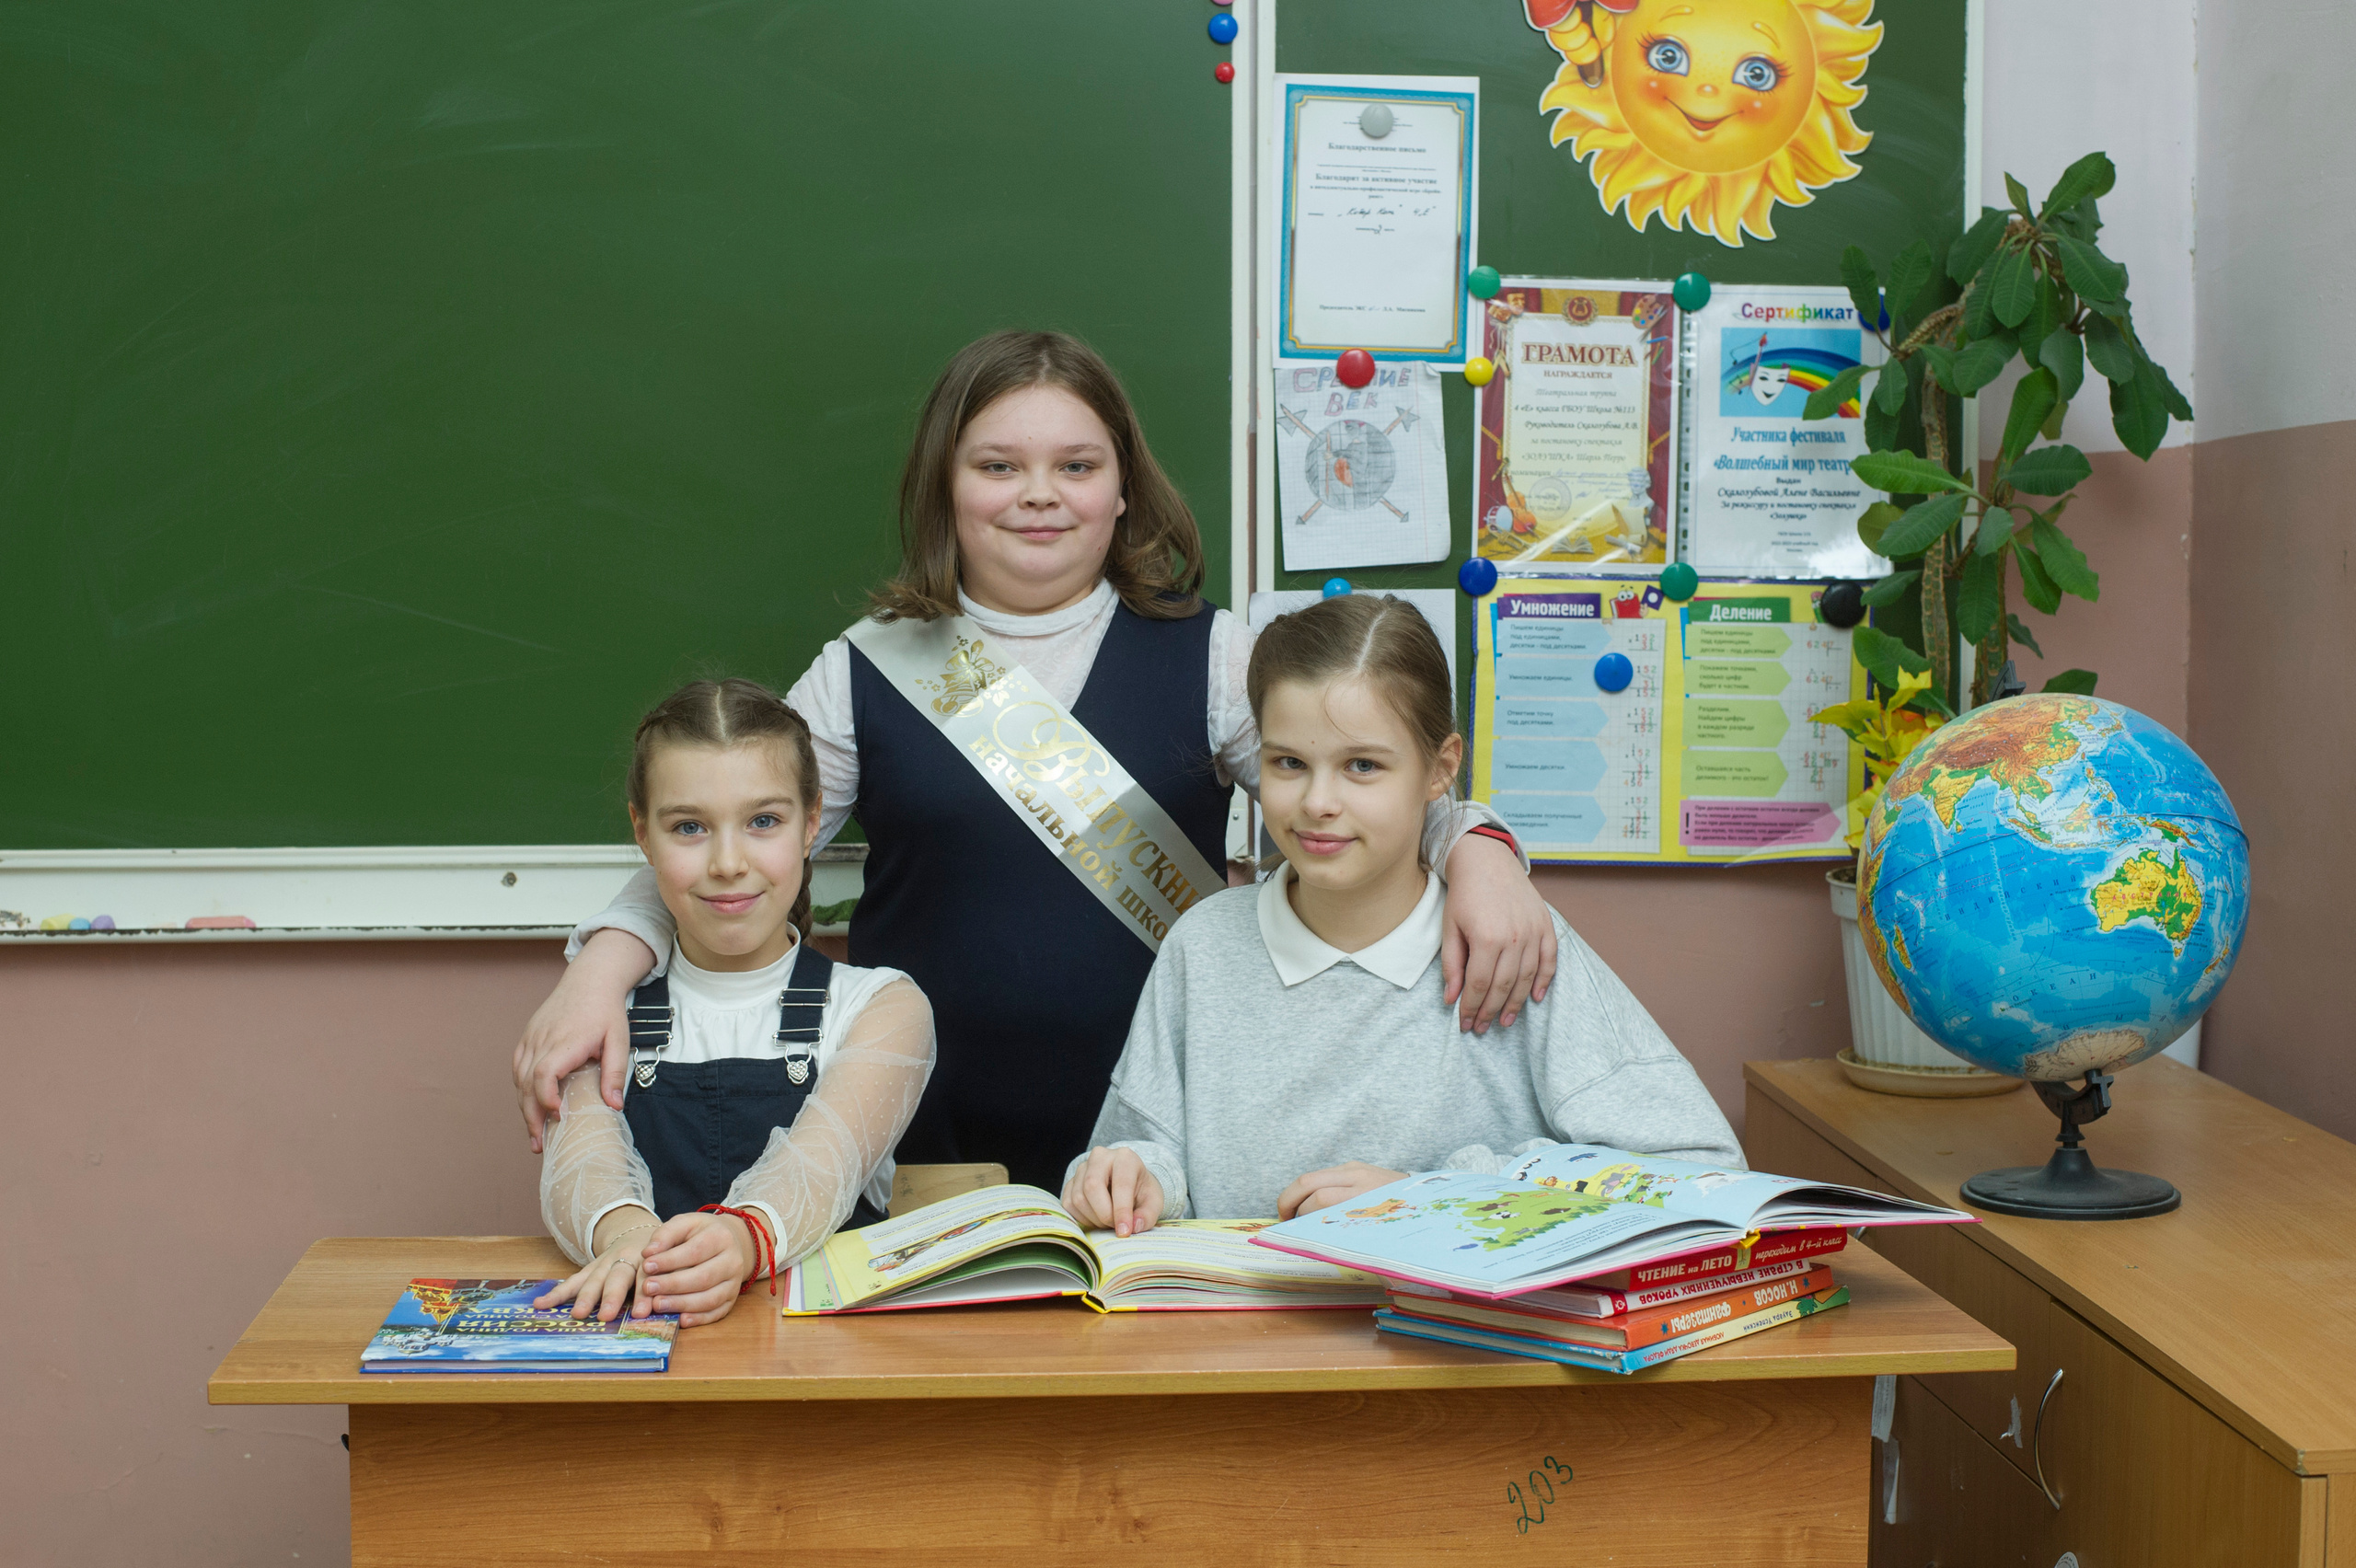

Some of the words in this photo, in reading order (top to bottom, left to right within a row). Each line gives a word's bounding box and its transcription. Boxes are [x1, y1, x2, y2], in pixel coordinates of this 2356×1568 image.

[1741, 303, 1854, 322] Сертификат
[1523, 343, 1635, 365] ГРАМОТА
[1543, 370, 1612, 379] НАГРАЖДАЕТСЯ
[1324, 391, 1379, 417] ВЕК
[1731, 426, 1787, 443] Участника
[1789, 426, 1846, 446] фестиваля
[1714, 455, 1788, 470] «Волшебный
[1792, 457, 1816, 475] мир
[1776, 477, 1801, 485] Выдан
[1510, 599, 1595, 617] Умножение
[1710, 605, 1772, 621] Деление
[1637, 1263, 1686, 1283] ЧТЕНИЕ
[1688, 1265, 1698, 1274] на
[1700, 1253, 1732, 1273] ЛЕТО
[1755, 1243, 1796, 1262] переходим
[1823, 1234, 1843, 1249] класс
[1796, 1260, 1804, 1271] В
[1758, 1261, 1794, 1278] СТРАНЕ
[1680, 1271, 1755, 1295] НЕВЫУЧЕННЫХ
[1785, 1279, 1798, 1294] Н.
[1638, 1287, 1679, 1305] УРОКОВ
[1753, 1283, 1787, 1307] НОСОВ
[458, 1320, 606, 1328] РОССИЯ
[1743, 1314, 1773, 1332] Успенский
[1663, 1344, 1678, 1355] ДЯДИ
[1677, 1338, 1701, 1353] ДЕВОЧКА
[1507, 1455, 1574, 1535] 203
